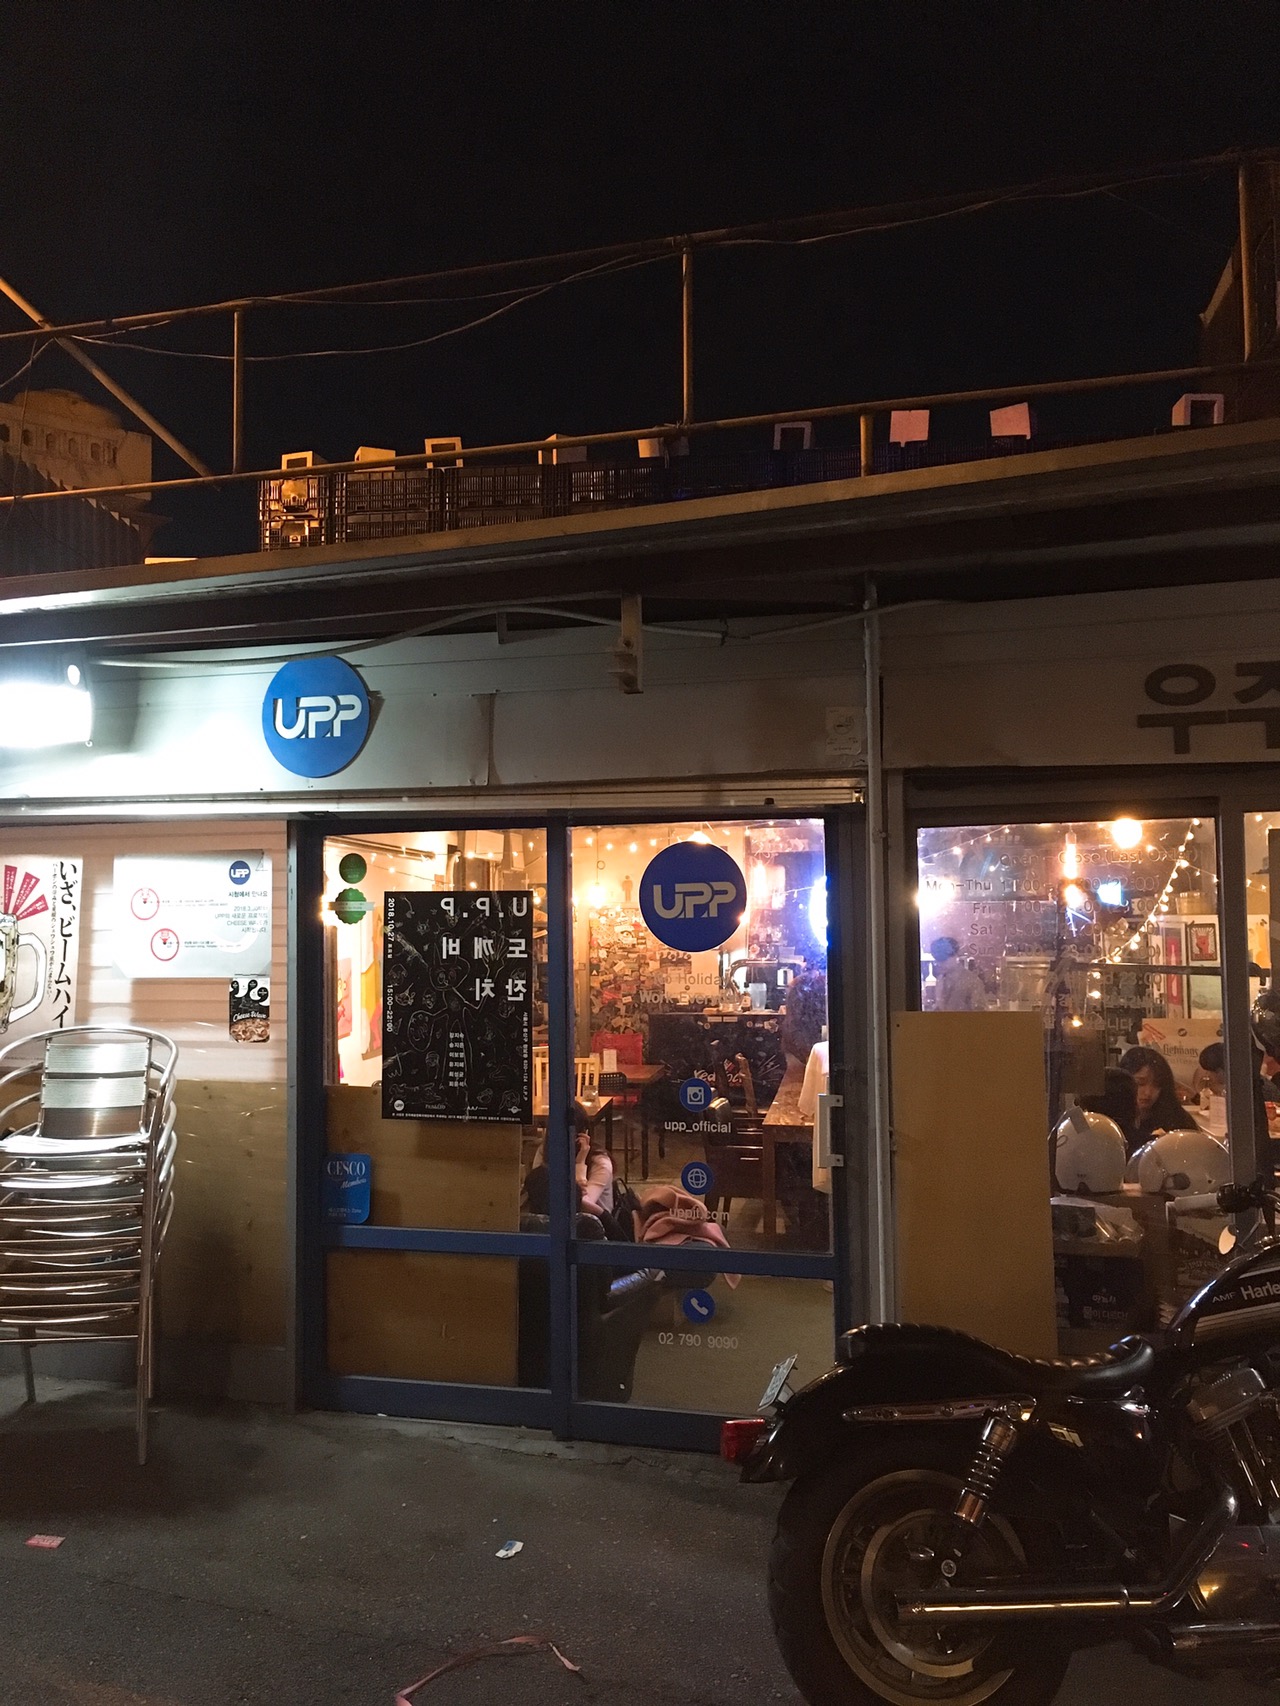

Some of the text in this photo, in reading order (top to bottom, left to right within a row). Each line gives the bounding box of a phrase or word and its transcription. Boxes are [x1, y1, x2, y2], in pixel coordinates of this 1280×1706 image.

[275, 694, 362, 739] UPP
[1000, 853, 1039, 868] Open
[1058, 850, 1101, 864] Cose
[230, 868, 250, 879] UPP
[653, 882, 736, 919] UPP
[973, 902, 991, 914] Fri
[970, 923, 993, 936] Sat
[969, 943, 995, 956] Sun
[639, 990, 674, 1004] Work
[386, 984, 394, 1033] 15:00-22:00
[664, 1119, 731, 1134] upp_official
[327, 1161, 366, 1176] CESCO
[1212, 1291, 1237, 1304] AMF
[658, 1332, 738, 1349] 02 790 9090
